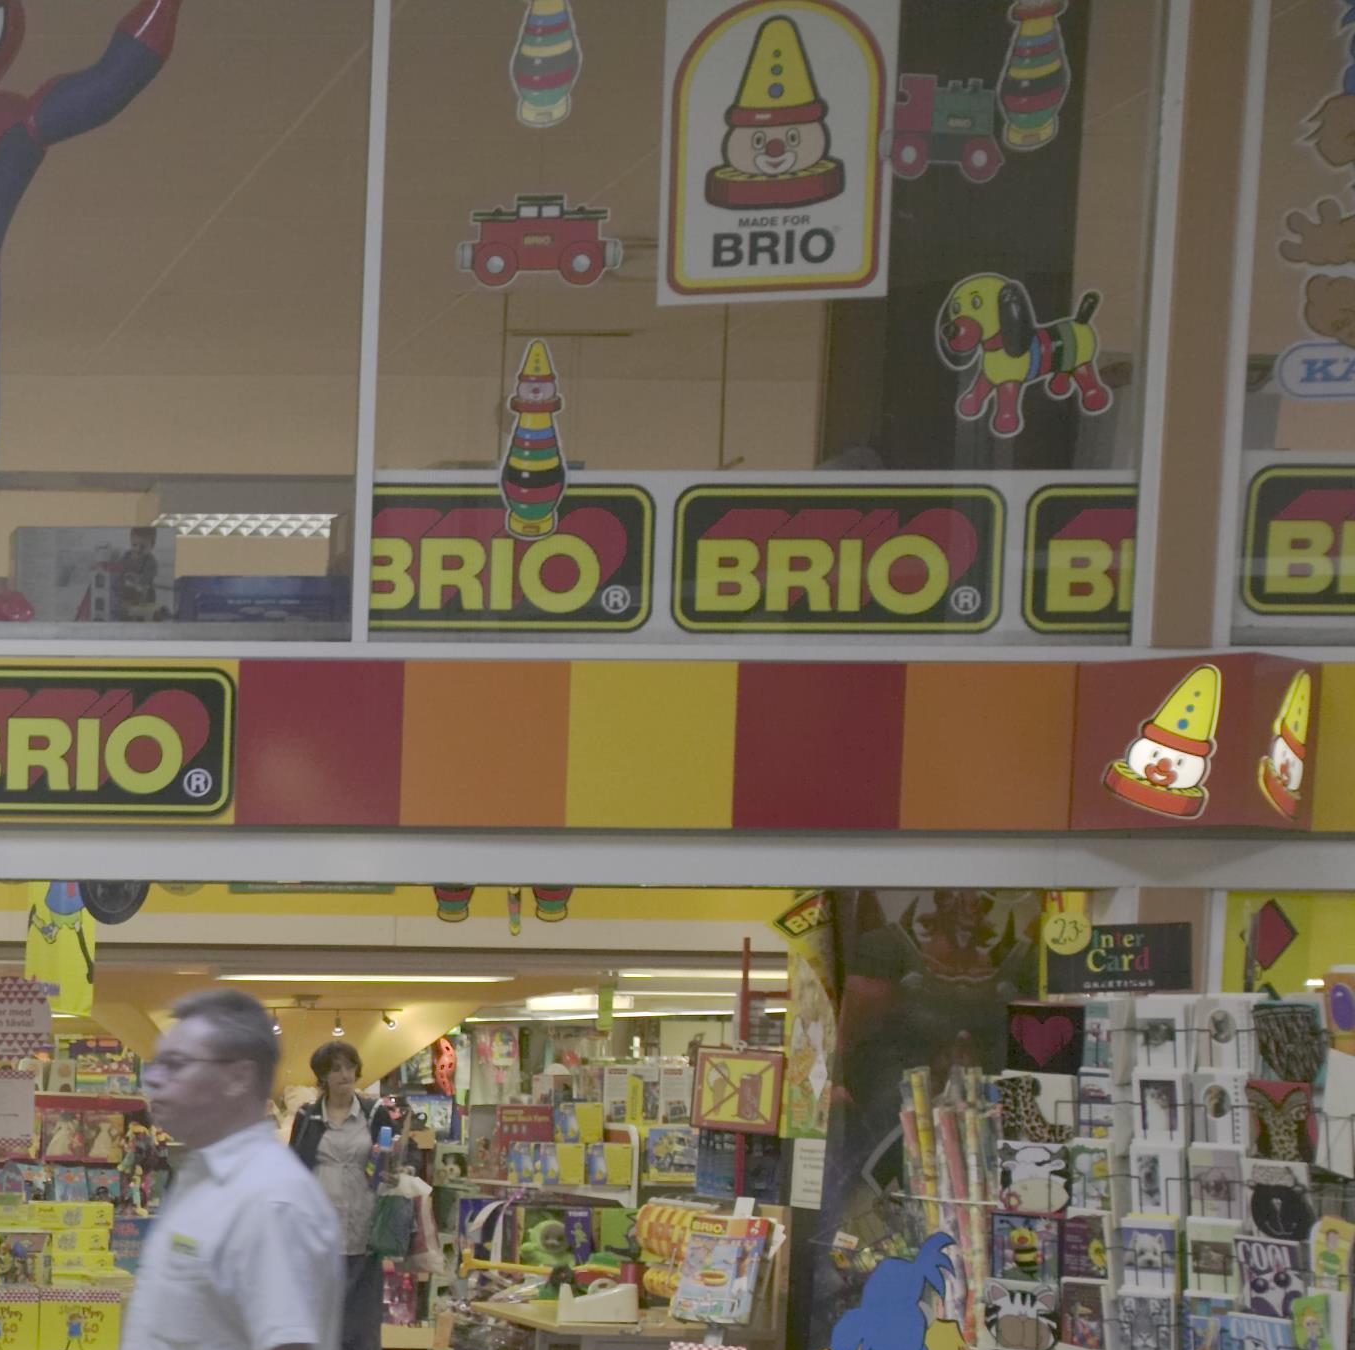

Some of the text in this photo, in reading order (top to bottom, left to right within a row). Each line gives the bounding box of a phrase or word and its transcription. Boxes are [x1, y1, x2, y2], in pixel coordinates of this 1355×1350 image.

[738, 214, 811, 228] MADE FOR
[711, 227, 836, 268] BRIO
[694, 533, 950, 615] BRIO
[1086, 947, 1150, 973] Card
[692, 1222, 724, 1234] BRIO
